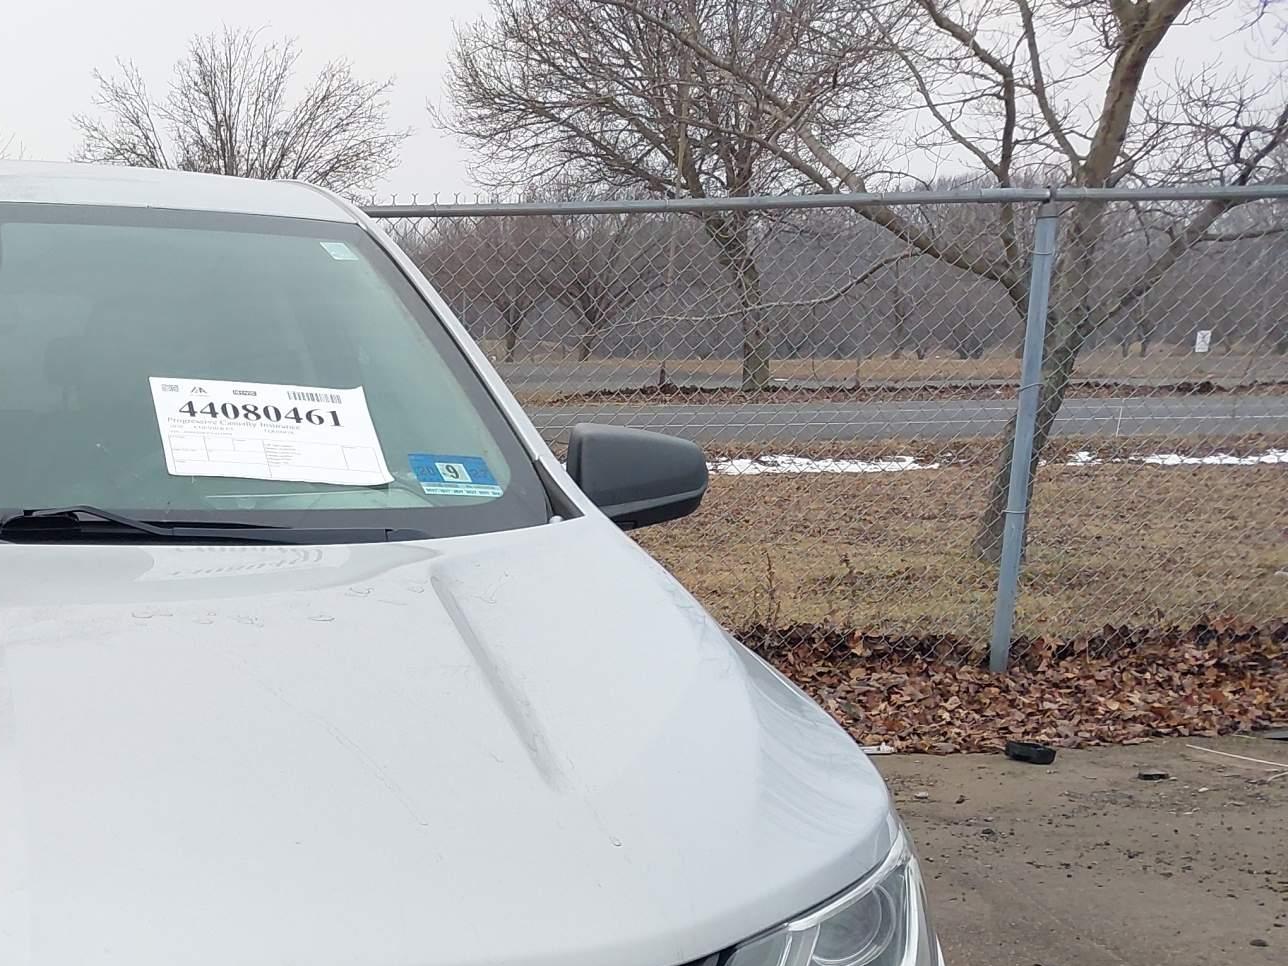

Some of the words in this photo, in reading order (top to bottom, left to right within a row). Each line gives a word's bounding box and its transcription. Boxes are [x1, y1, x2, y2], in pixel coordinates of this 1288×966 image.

[167, 416, 218, 426] Progressive
[179, 400, 344, 428] 44080461
[445, 464, 460, 480] 9
